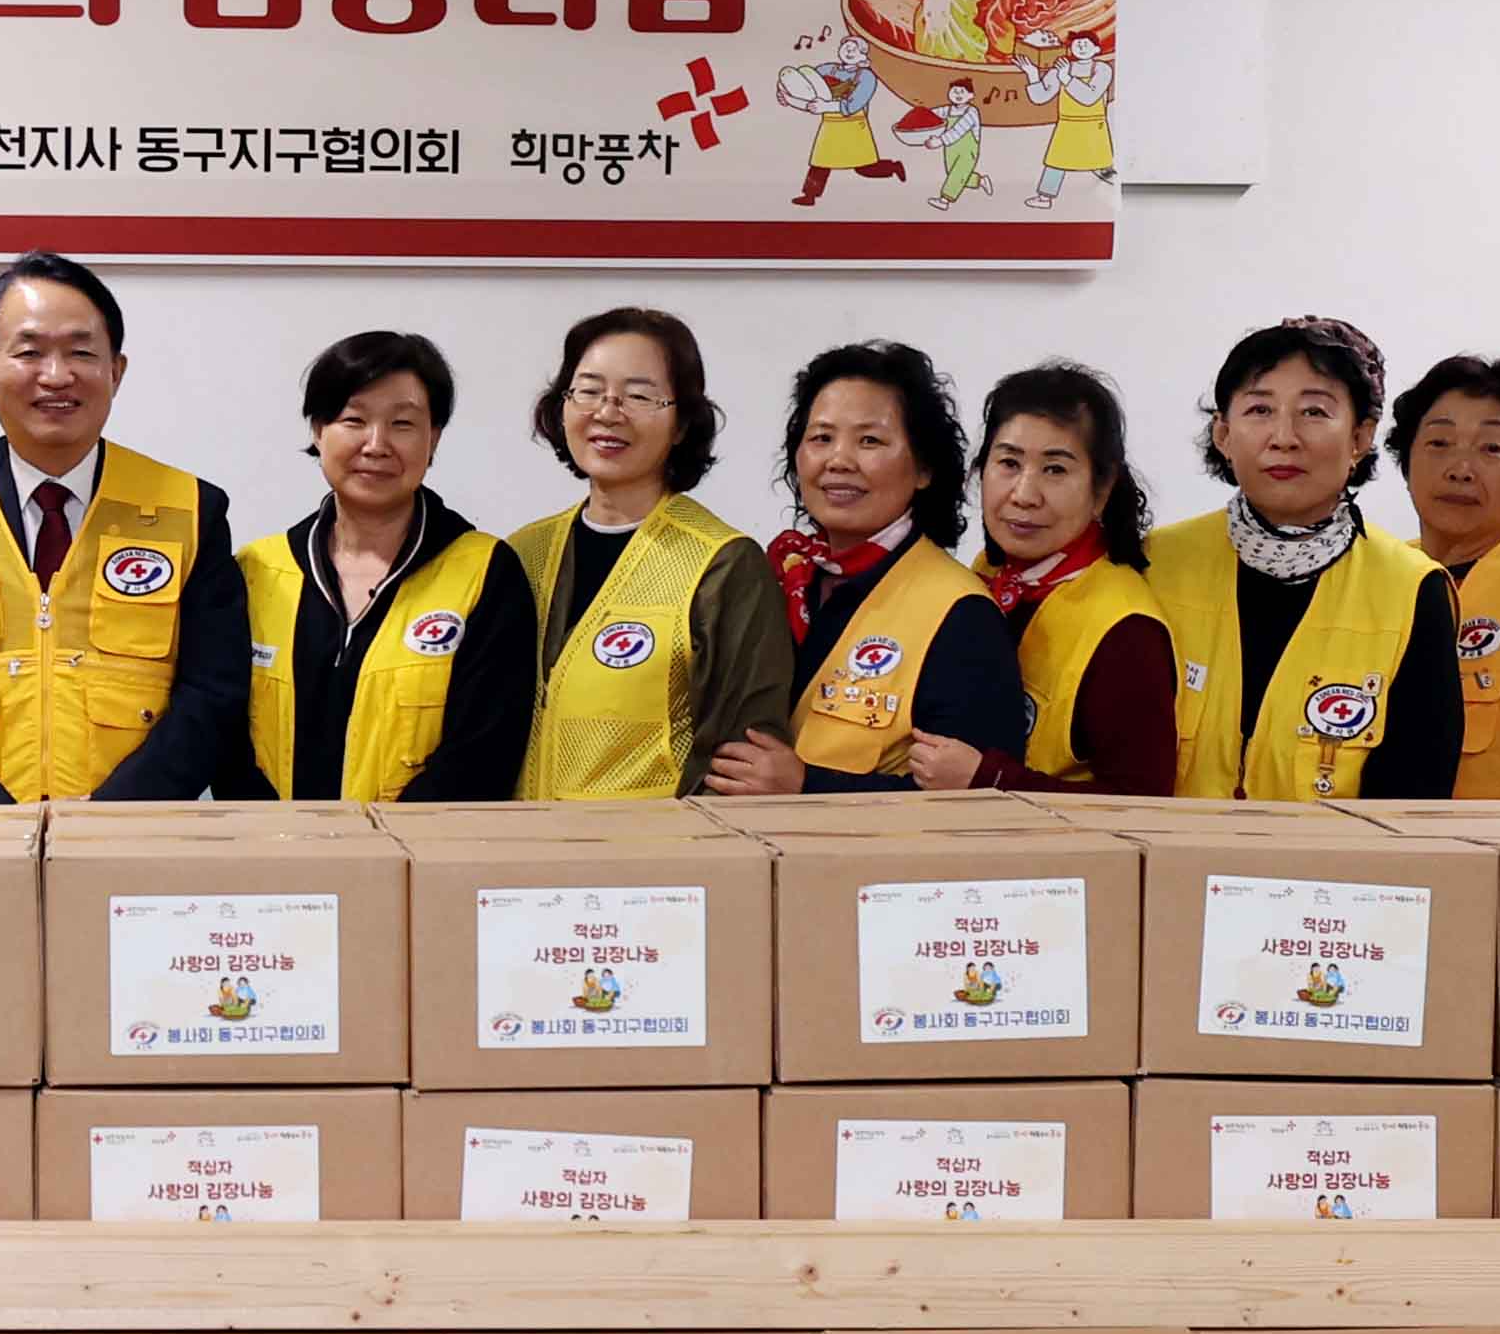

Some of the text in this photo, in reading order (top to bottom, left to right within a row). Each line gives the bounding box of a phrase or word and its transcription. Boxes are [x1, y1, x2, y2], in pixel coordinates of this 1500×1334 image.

[136, 124, 460, 174] 동구지구협의회
[510, 126, 681, 186] 희망풍차
[953, 915, 1001, 934] 적십자
[913, 937, 1042, 960] 사랑의 김장나눔
[1306, 1150, 1352, 1166] 적십자
[1267, 1172, 1391, 1190] 사랑의 김장나눔
